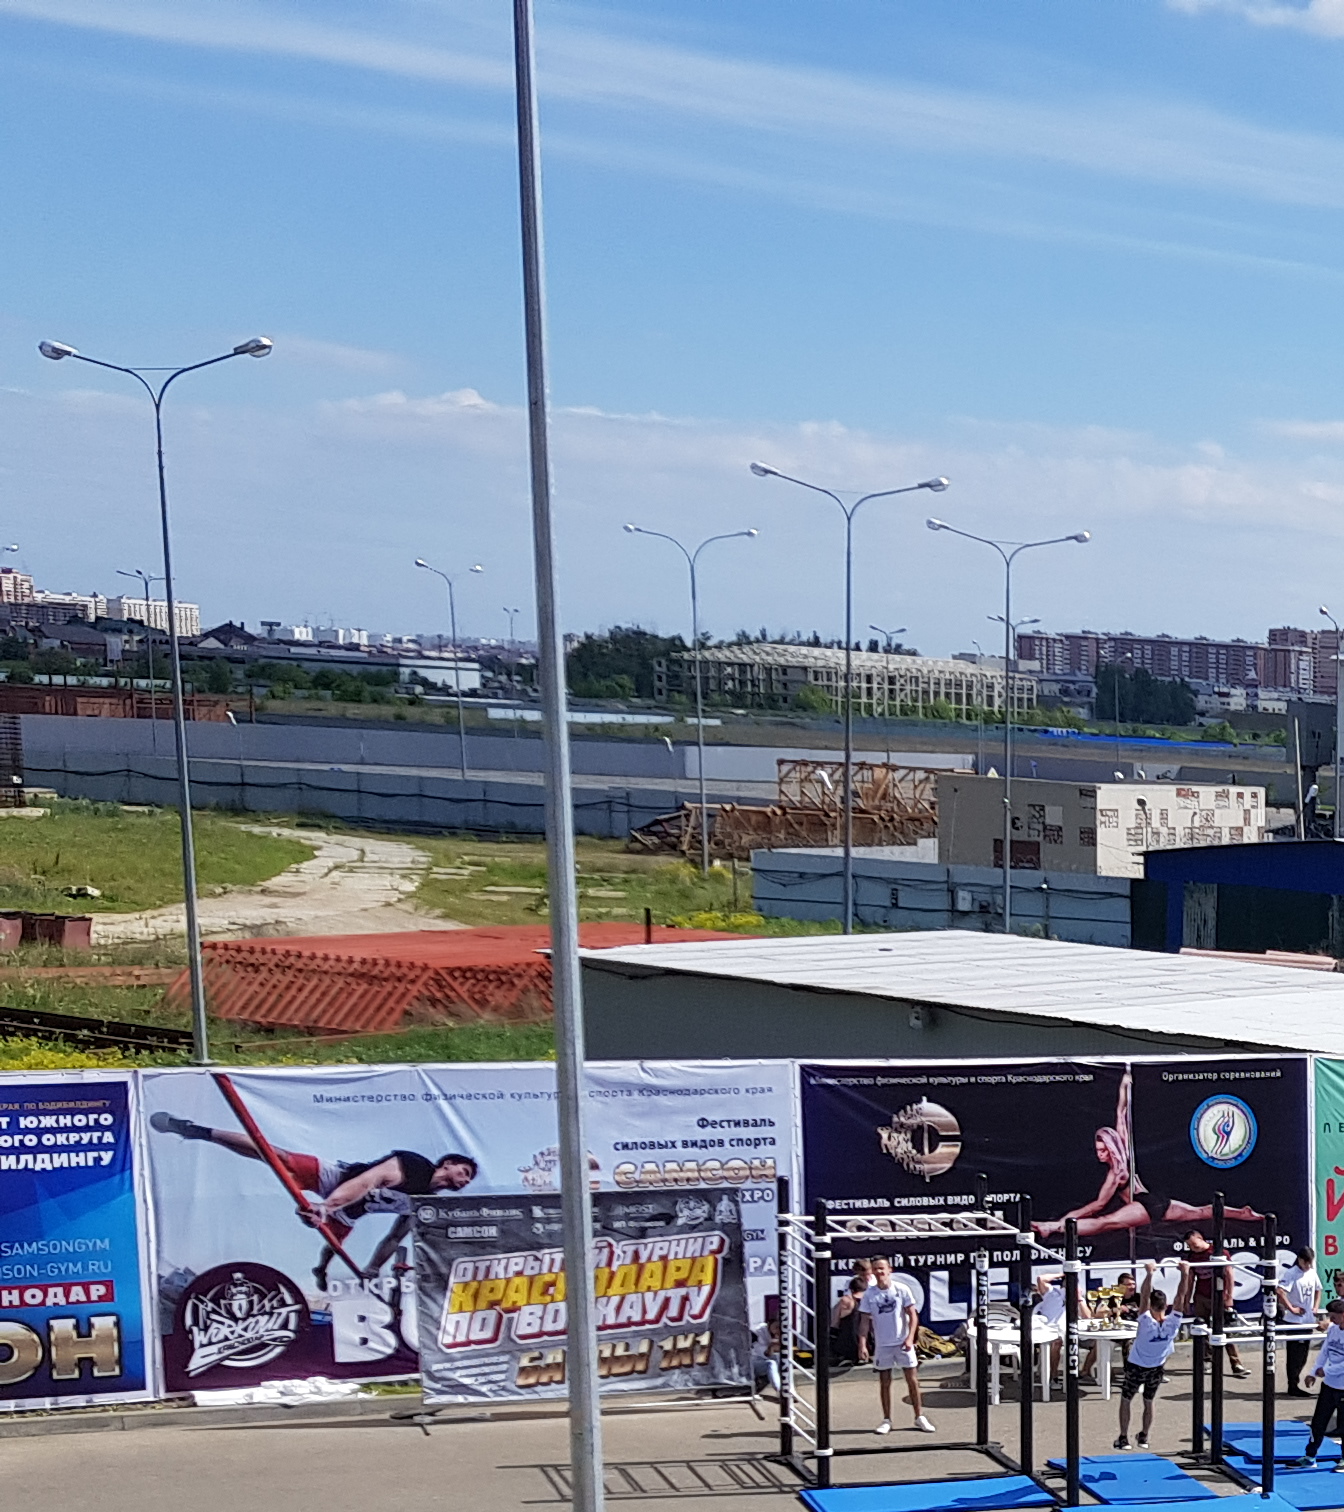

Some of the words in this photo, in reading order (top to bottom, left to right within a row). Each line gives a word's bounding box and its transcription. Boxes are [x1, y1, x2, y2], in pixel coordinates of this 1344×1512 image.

[978, 1076, 1006, 1085] спорта
[1008, 1074, 1073, 1084] Краснодарского
[1075, 1074, 1094, 1083] края
[1162, 1071, 1218, 1082] Организатор
[1220, 1069, 1281, 1080] соревнований
[313, 1092, 416, 1104] Министерство
[638, 1086, 740, 1098] Краснодарского
[745, 1086, 773, 1095] края
[24, 1102, 36, 1110] ПО
[19, 1113, 113, 1129] ЮЖНОГО
[697, 1118, 776, 1130] Фестиваль
[41, 1131, 115, 1146] ОКРУГА
[613, 1139, 676, 1151] силовых
[682, 1138, 725, 1149] видов
[729, 1136, 776, 1149] спорта
[613, 1157, 777, 1188] САМСОН
[826, 1198, 890, 1210] ФЕСТИВАЛЬ
[894, 1197, 945, 1208] СИЛОВЫХ
[947, 1194, 975, 1206] ВИДО
[448, 1225, 498, 1239] САМСОН
[1, 1237, 110, 1257] SAMSONGYM
[1324, 1234, 1339, 1256] В
[455, 1241, 612, 1283] ОТКРЫТЙ
[619, 1235, 719, 1265] ТУРНИР
[909, 1253, 965, 1268] ТУРНИР
[993, 1249, 1020, 1262] ПОЛ
[0, 1260, 112, 1279] SON-GYM.RU
[1, 1284, 107, 1307] НОДАР
[978, 1274, 988, 1324] #FSCT
[442, 1308, 499, 1345] ПО
[516, 1284, 712, 1335] ВОКАУТУ
[1068, 1321, 1079, 1378] #FSCT
[1265, 1319, 1275, 1375] #FSCT
